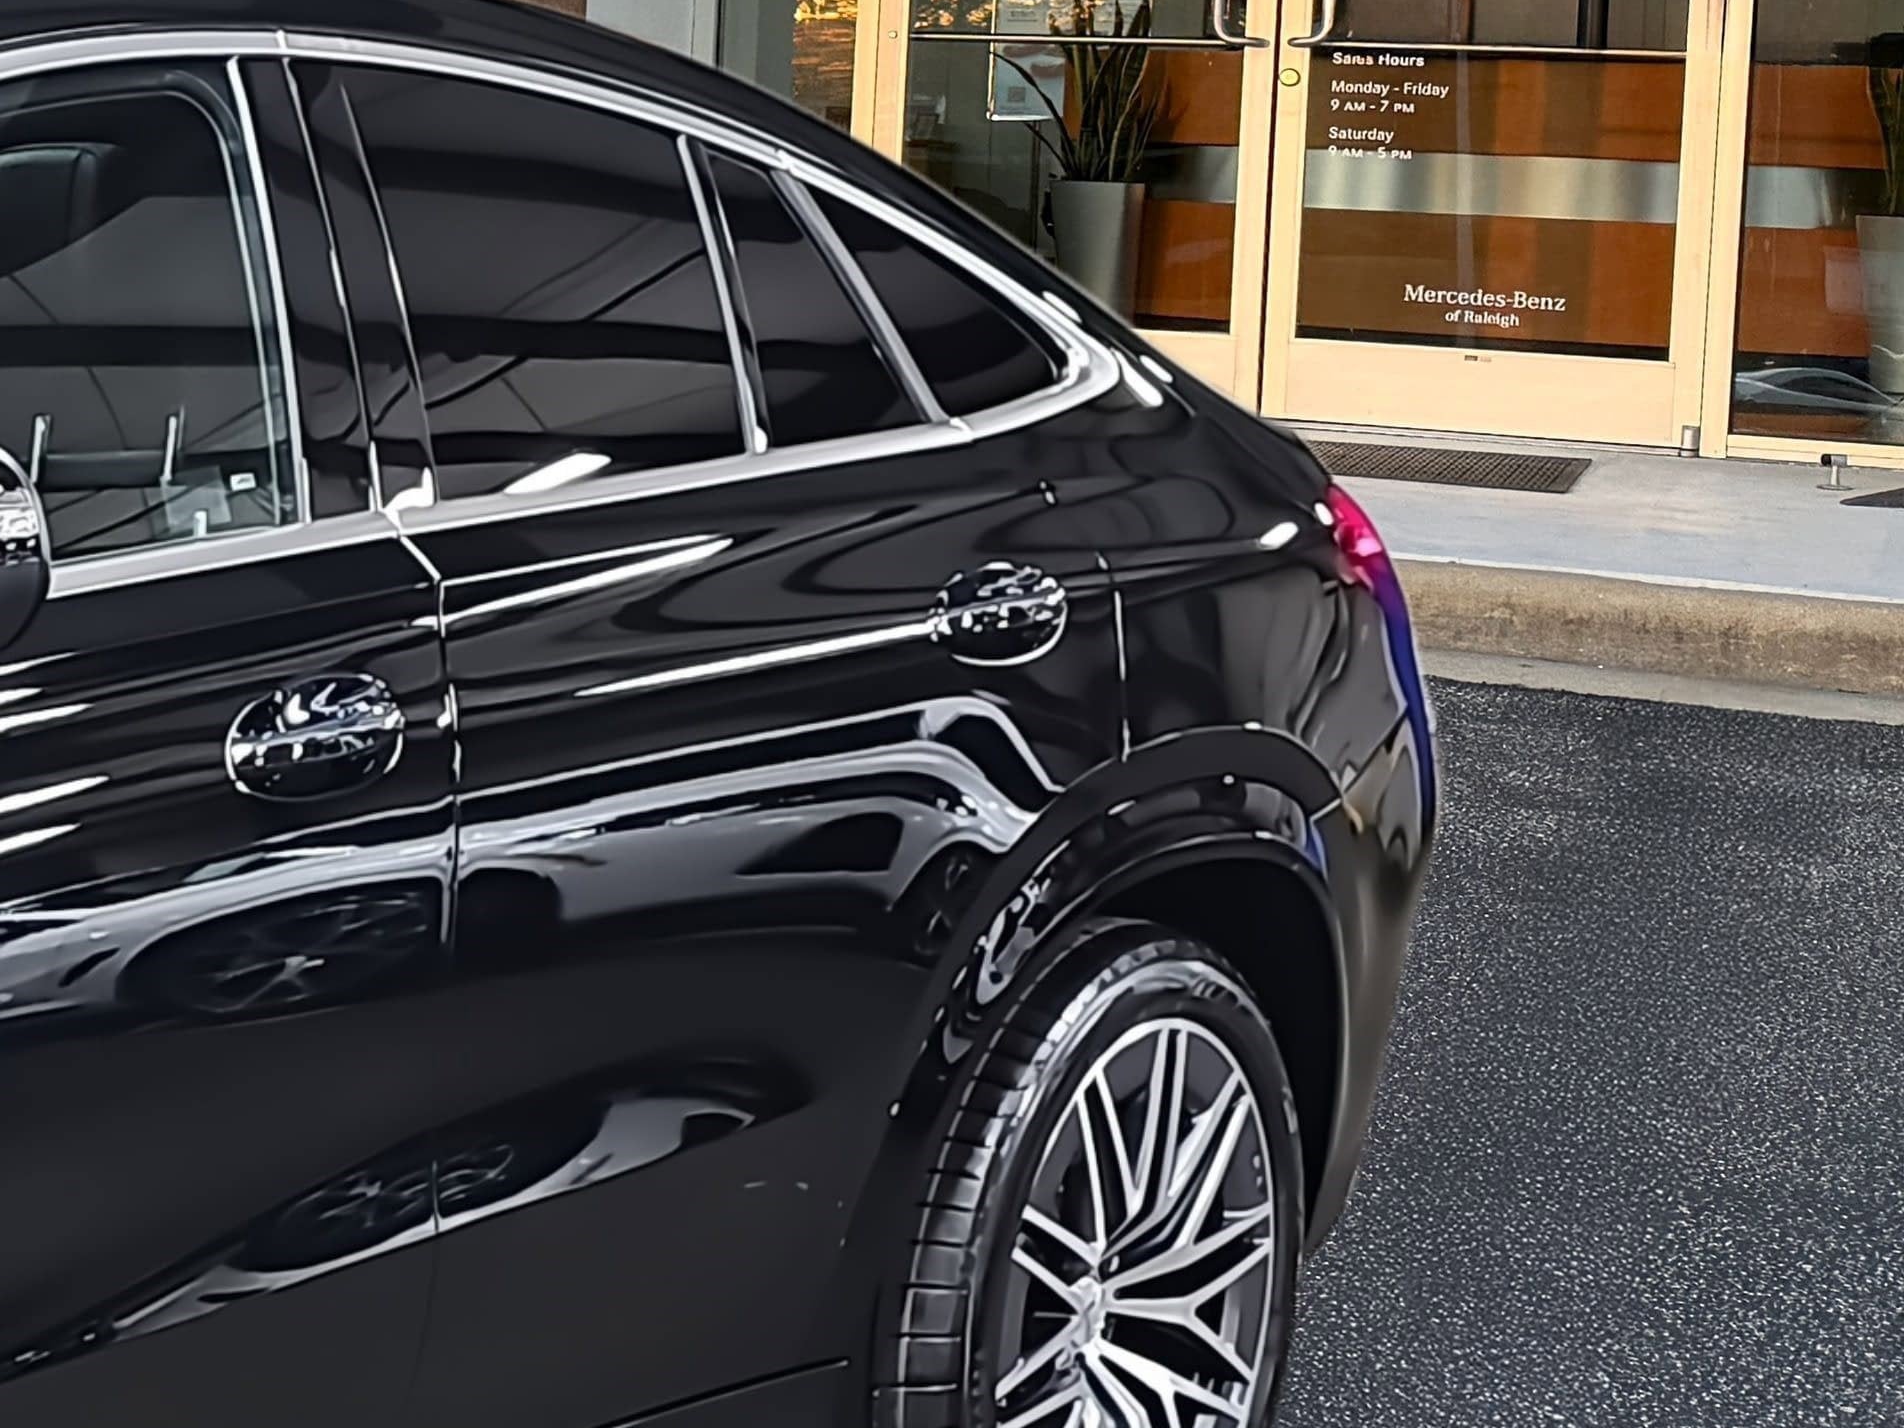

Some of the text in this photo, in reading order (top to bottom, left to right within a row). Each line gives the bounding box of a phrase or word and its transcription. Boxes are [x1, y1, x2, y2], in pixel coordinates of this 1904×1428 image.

[1378, 53, 1424, 66] Hours
[1331, 80, 1390, 97] Monday
[1403, 82, 1449, 98] Friday
[1330, 99, 1340, 111] 9
[1344, 102, 1365, 111] AM
[1379, 100, 1389, 112] 7
[1393, 103, 1415, 113] PM
[1328, 127, 1394, 144] Saturday
[1328, 145, 1338, 157] 9
[1342, 148, 1364, 158] AM
[1378, 147, 1386, 158] 5
[1392, 149, 1412, 160] PM
[1403, 283, 1566, 311] Mercedes-Benz
[1445, 309, 1520, 328] of Raleigh
